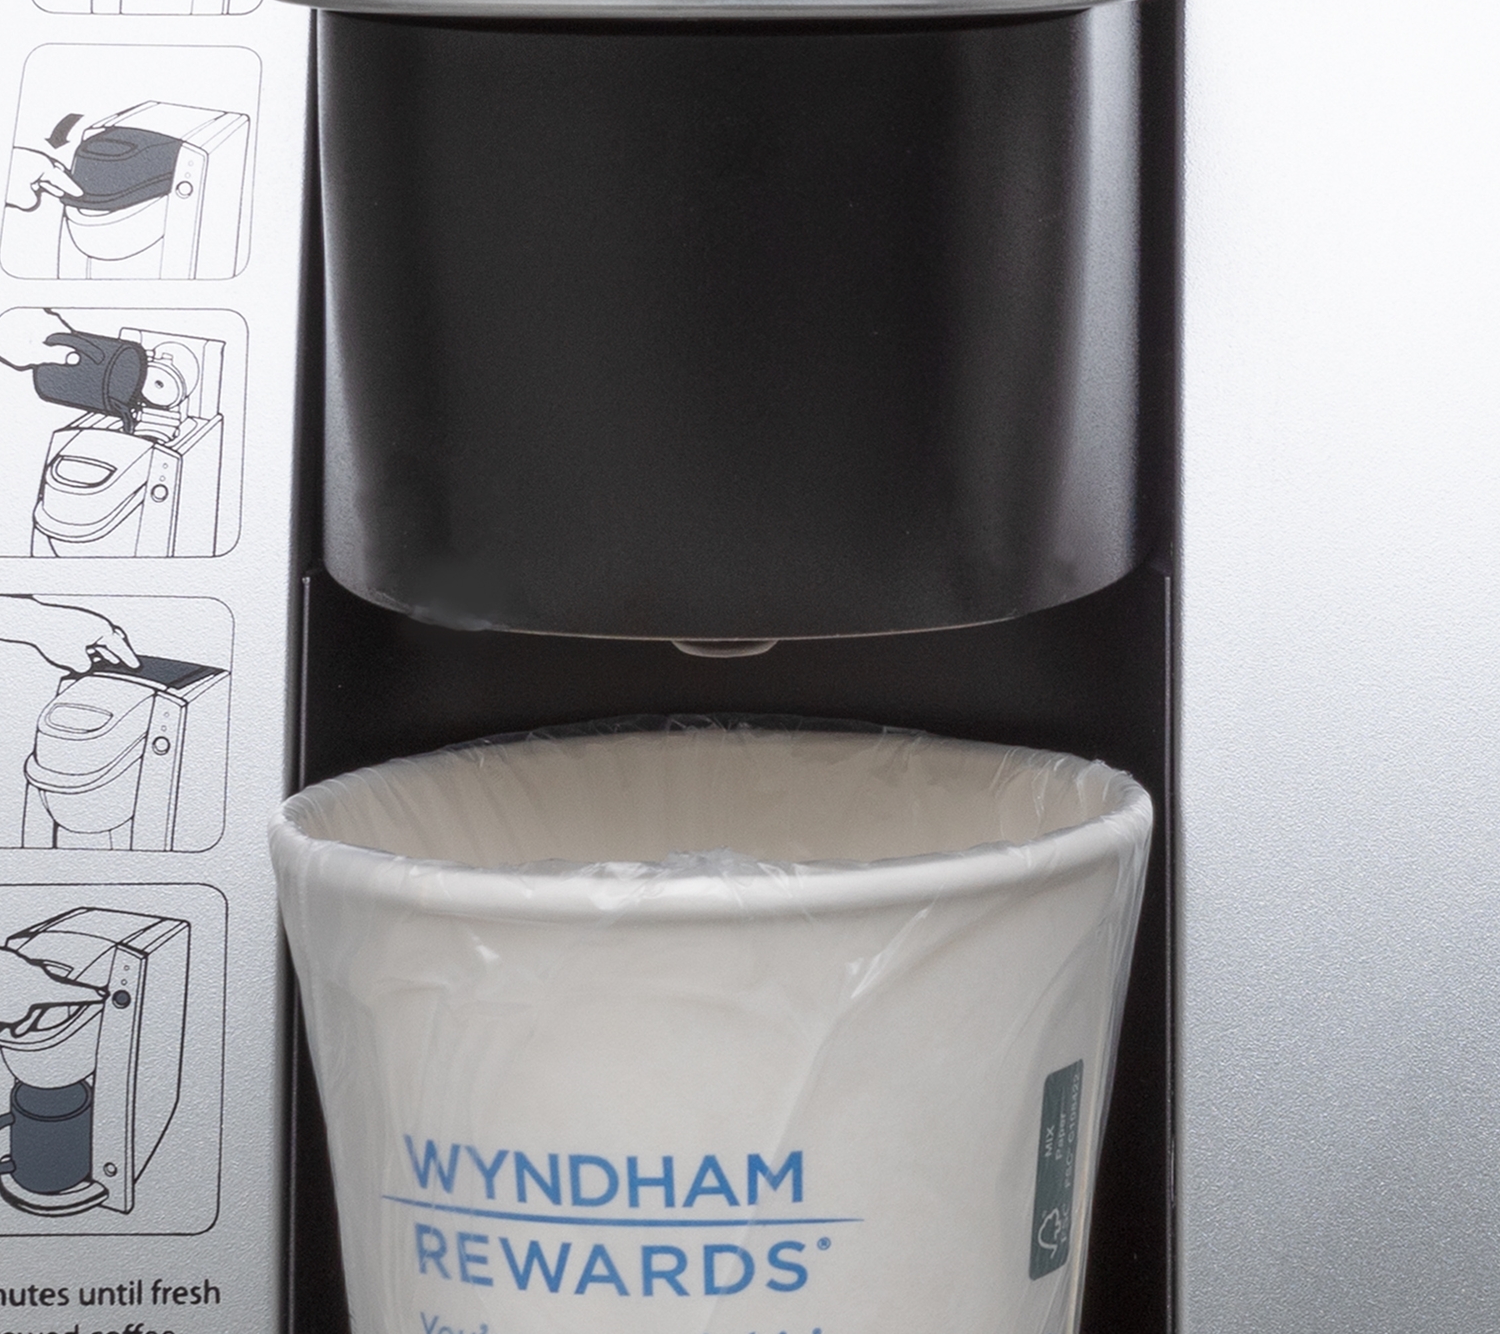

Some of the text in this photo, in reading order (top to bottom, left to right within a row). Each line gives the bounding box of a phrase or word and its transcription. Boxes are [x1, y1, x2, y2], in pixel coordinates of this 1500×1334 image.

[1044, 1125, 1055, 1158] MIX
[1054, 1112, 1067, 1161] Paper
[403, 1133, 805, 1209] WYNDHAM
[78, 1278, 144, 1307] until
[149, 1277, 222, 1306] fresh
